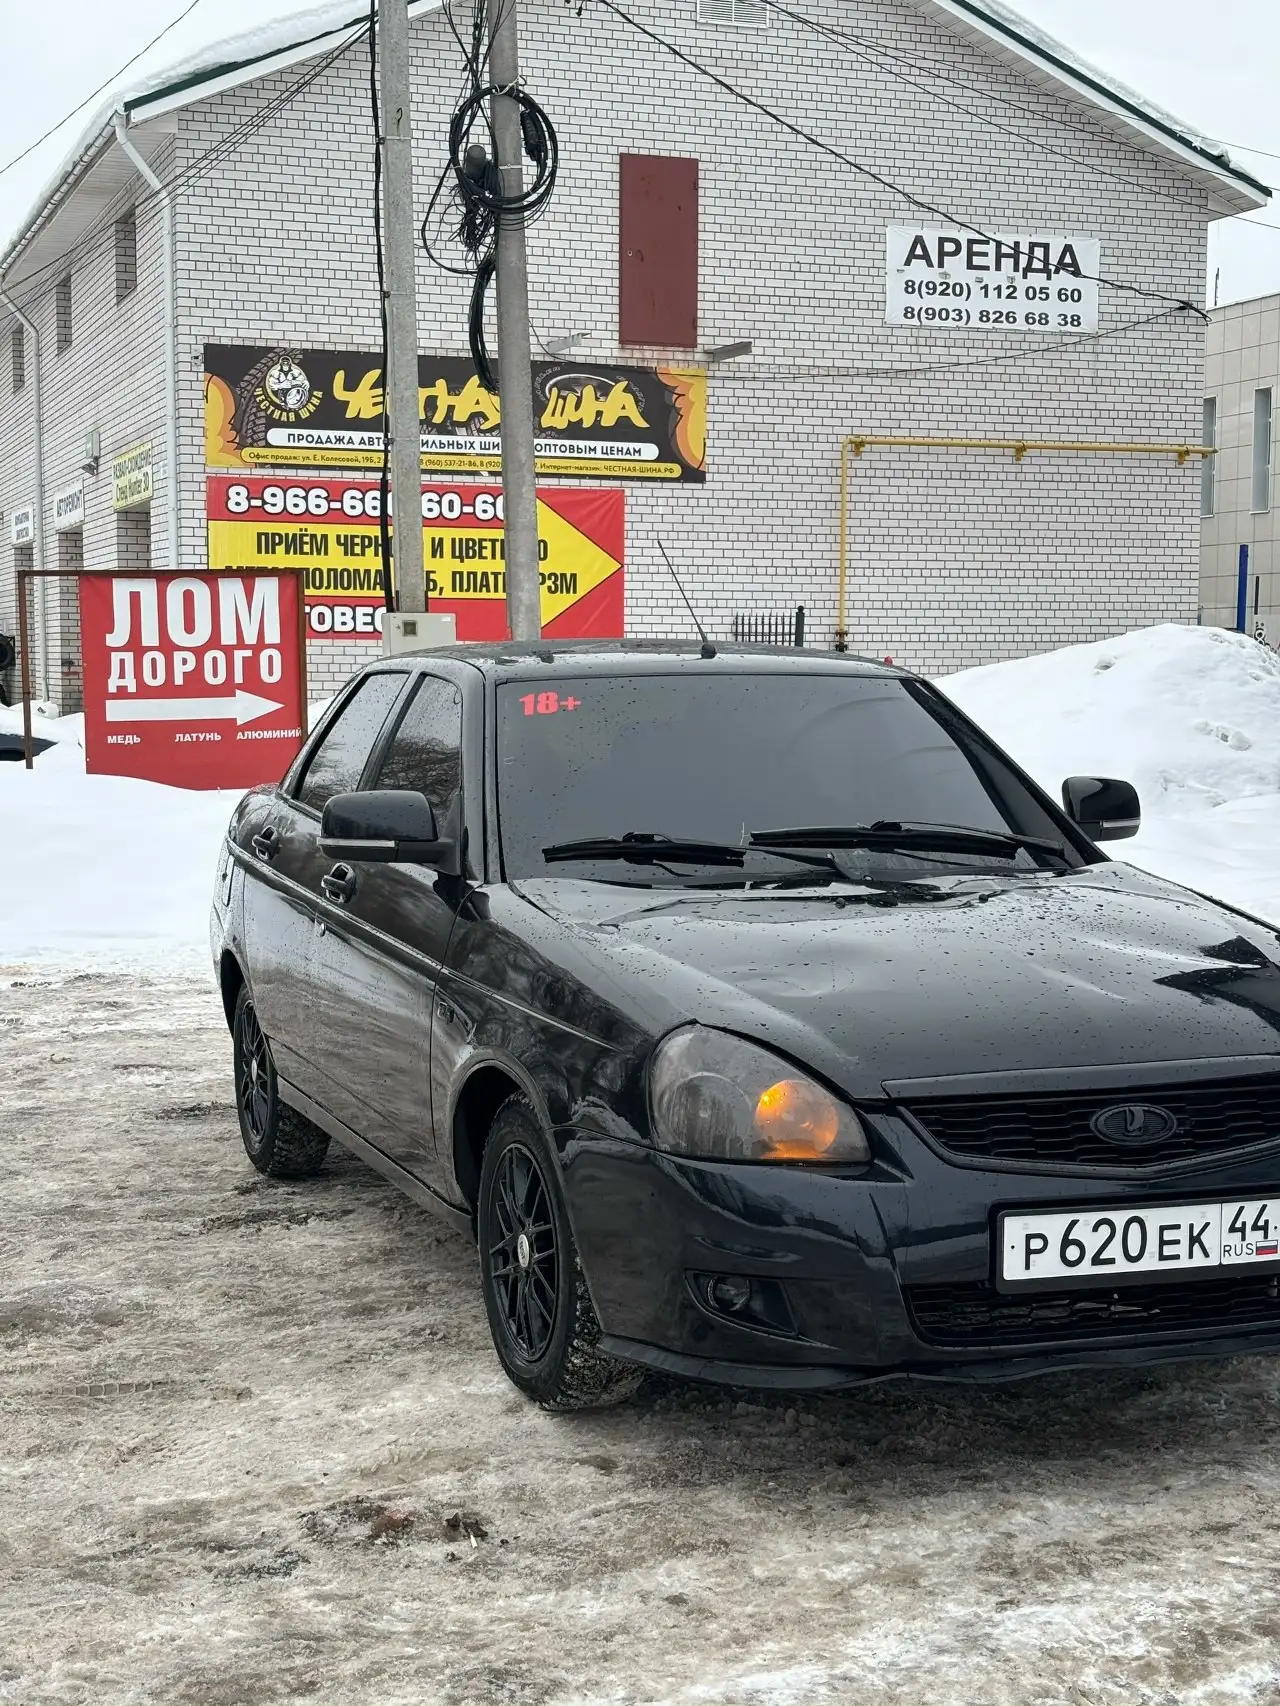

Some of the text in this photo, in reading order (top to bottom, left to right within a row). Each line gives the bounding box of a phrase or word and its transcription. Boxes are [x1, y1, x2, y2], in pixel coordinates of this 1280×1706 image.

[904, 235, 1082, 281] АРЕНДА
[904, 279, 1082, 303] 8(920) 112 05 60
[903, 306, 1082, 327] 8(903) 826 68 38
[254, 387, 324, 422] ЧЕСТНАЯ ШИНА
[541, 381, 650, 430] ШИНА
[249, 452, 270, 461] Офис
[287, 433, 642, 457] ПРОДАЖА АВТИЛЬНЫХ ШИ ОПТОВЫМ ЦЕНАМ
[256, 528, 329, 556] ПРИЁМ
[431, 537, 444, 559] И
[105, 577, 281, 648] ЛОМ
[107, 648, 282, 693] ДОРОГО
[519, 691, 582, 716] 18+
[107, 727, 302, 745] МЕДЬ ЛАТУНЬ АЛЮМИНИЙ
[1227, 1203, 1269, 1242] 44
[1223, 1243, 1254, 1258] RUS
